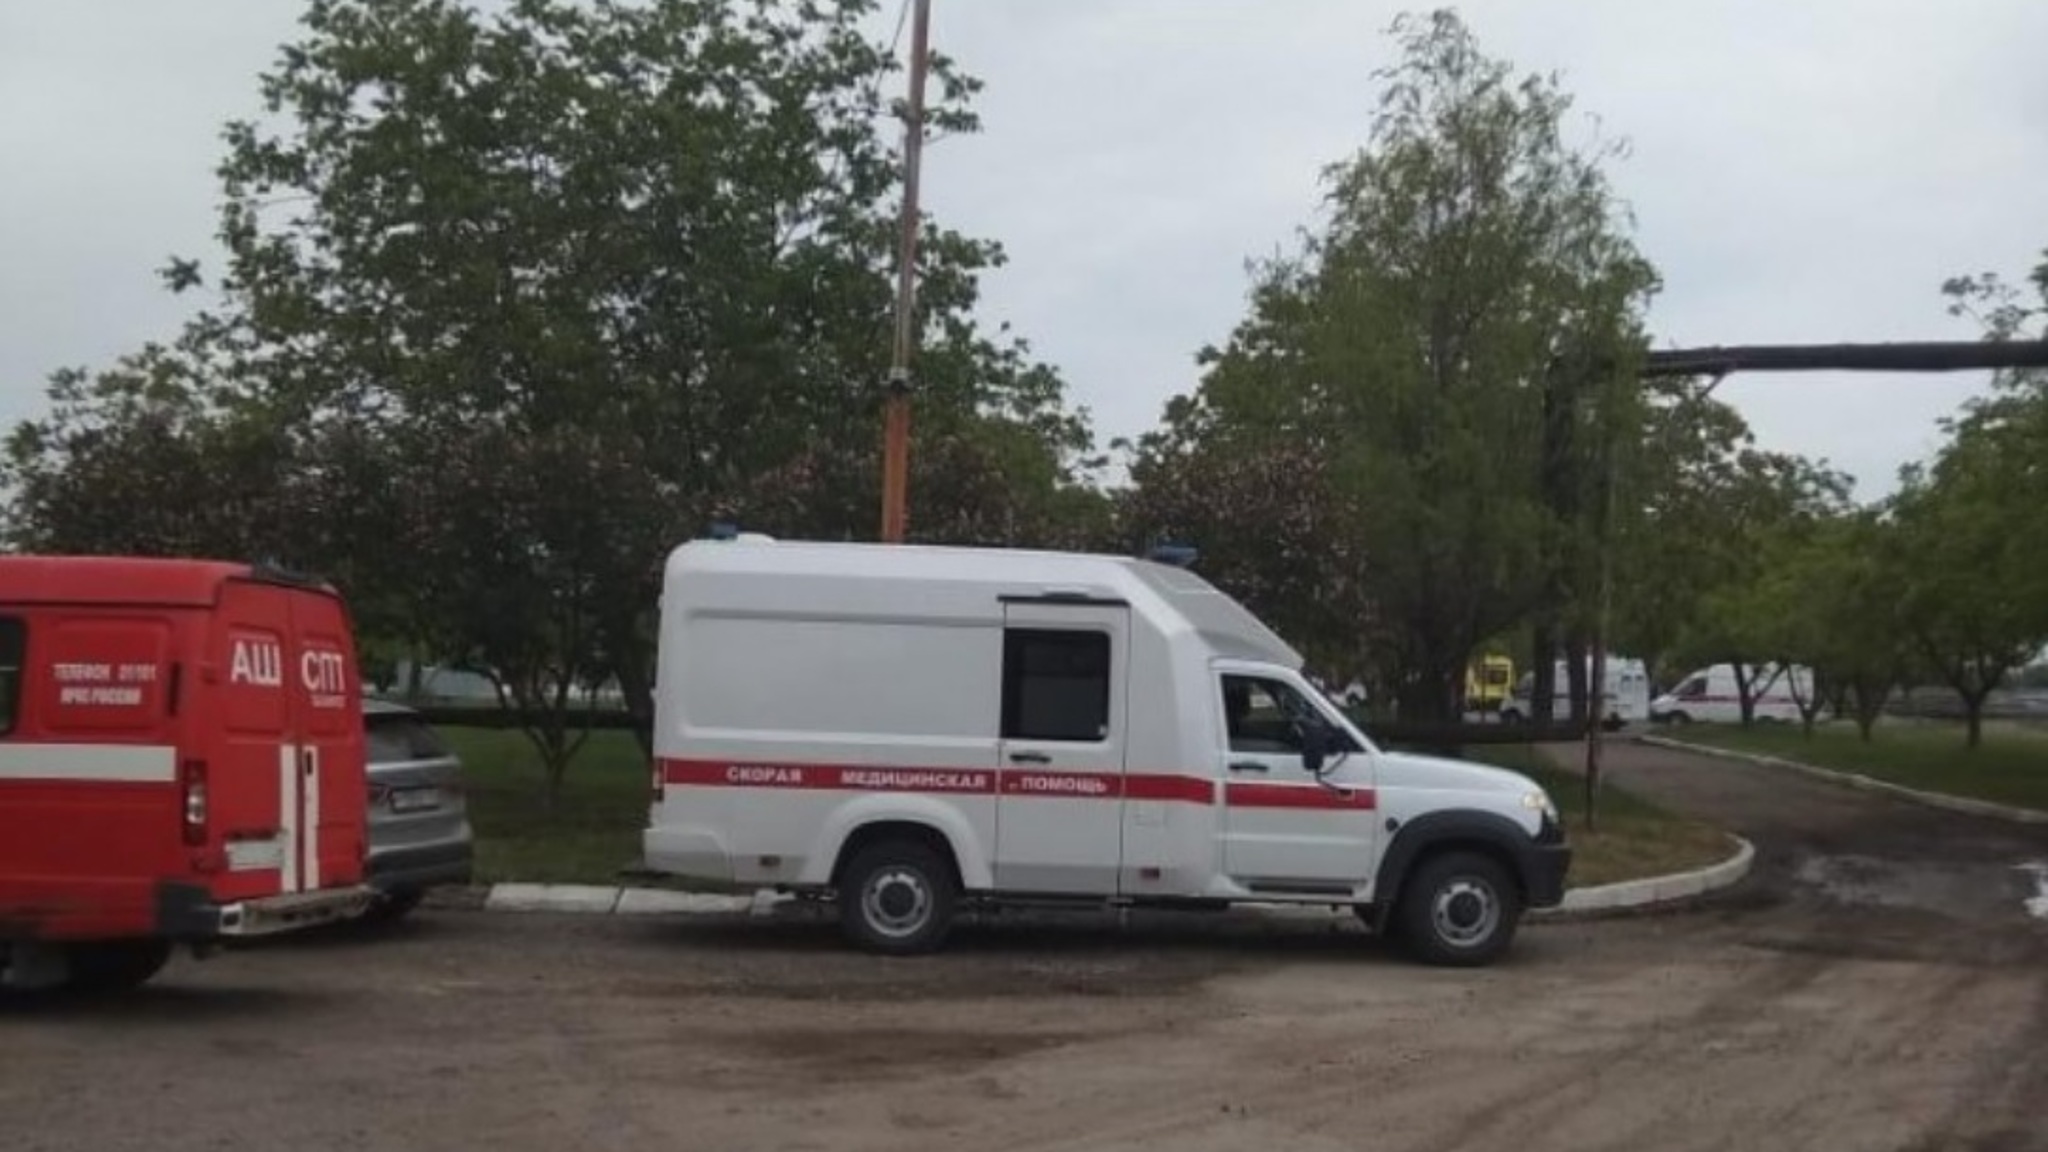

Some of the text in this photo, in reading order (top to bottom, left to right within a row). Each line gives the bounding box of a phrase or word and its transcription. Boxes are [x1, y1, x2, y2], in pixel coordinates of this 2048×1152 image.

[230, 640, 281, 686] АШ
[726, 766, 1107, 793] СКОРАЯ МЕДИЦИНСКАЯ ПОМОЩЬ
